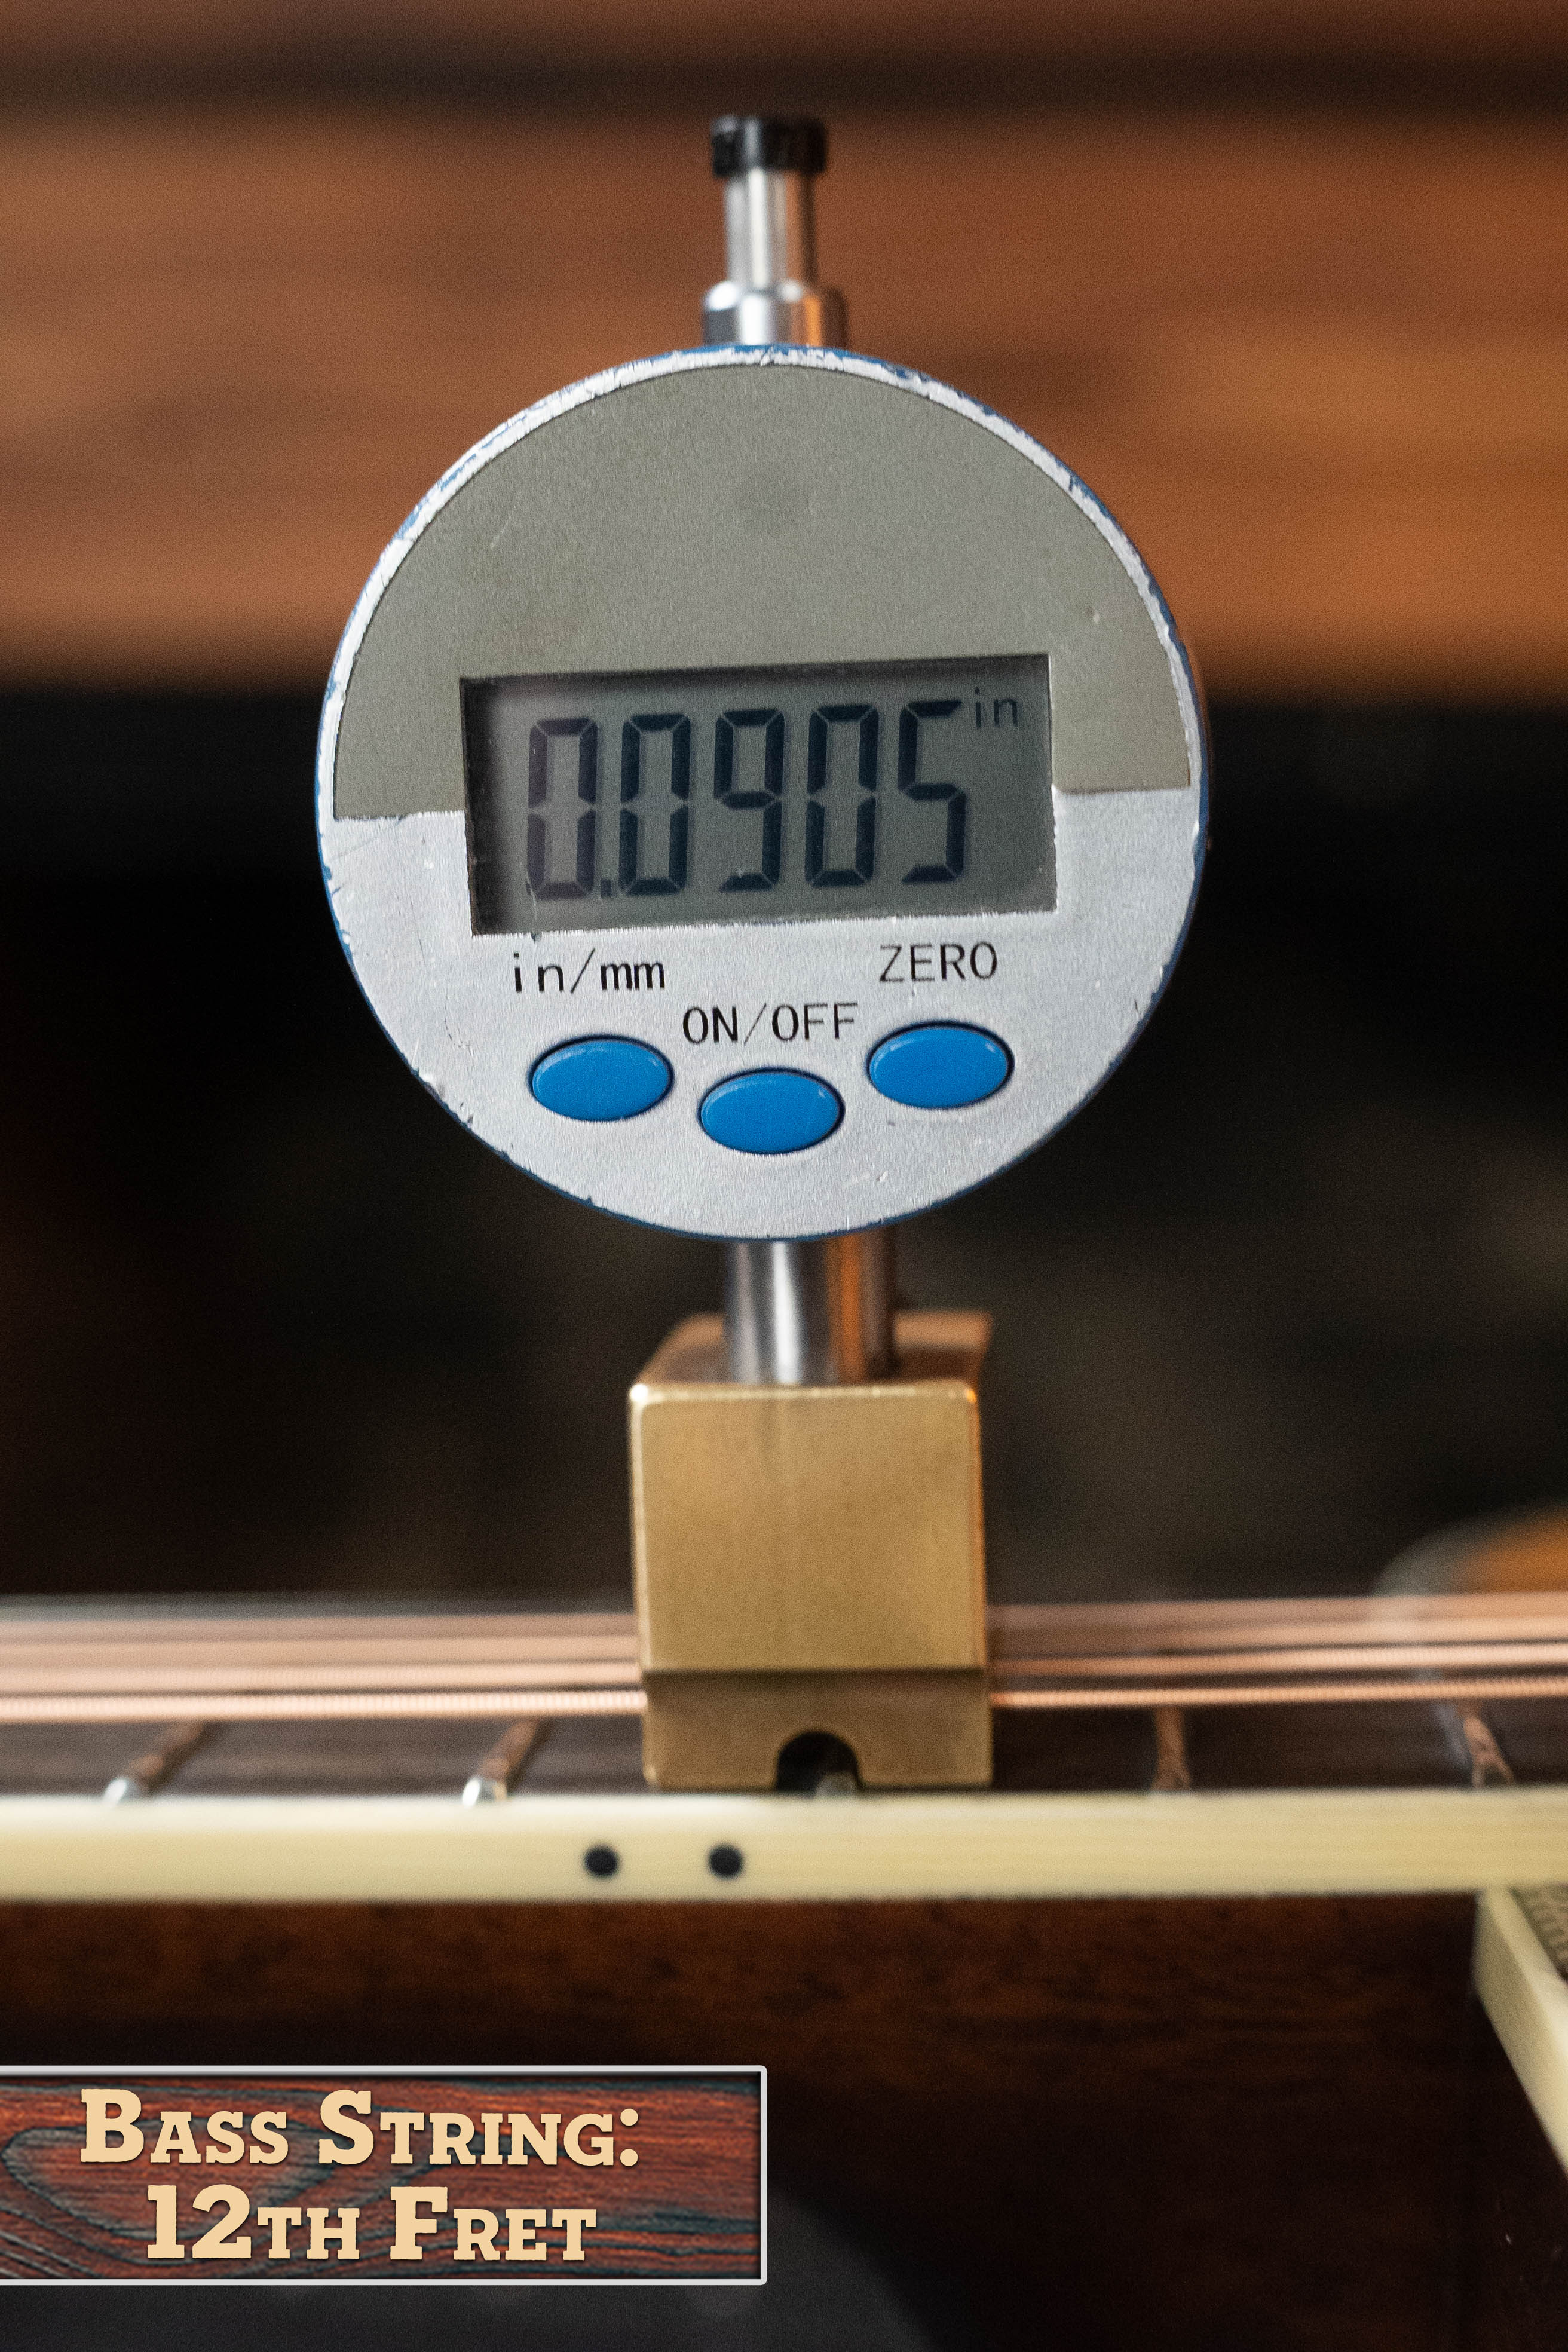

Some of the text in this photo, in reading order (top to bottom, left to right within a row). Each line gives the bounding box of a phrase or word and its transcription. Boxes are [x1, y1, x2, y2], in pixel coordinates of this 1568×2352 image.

[975, 688, 1019, 729] in
[528, 700, 967, 899] 0.0905
[513, 948, 666, 994] in/mm
[879, 942, 997, 983] ZERO
[682, 1003, 859, 1045] ON/OFF
